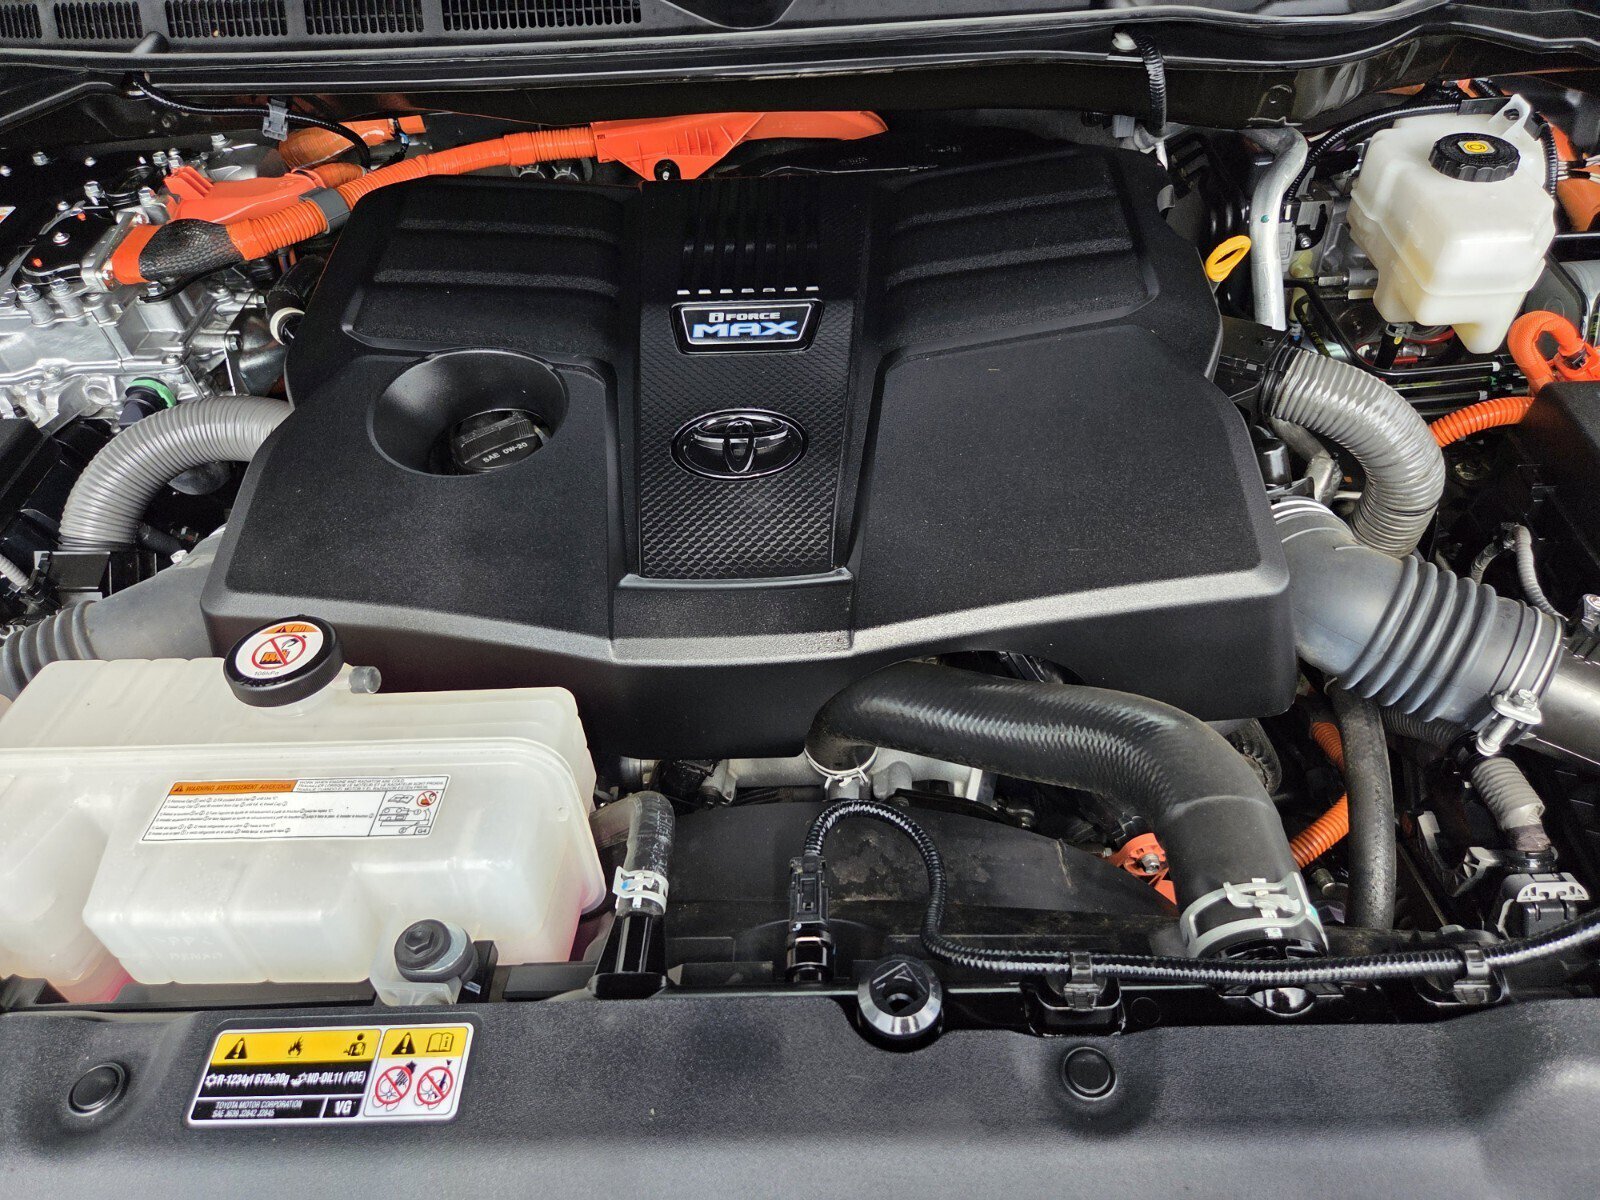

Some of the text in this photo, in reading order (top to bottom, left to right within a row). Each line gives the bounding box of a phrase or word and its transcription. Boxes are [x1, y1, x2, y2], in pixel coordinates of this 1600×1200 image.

[692, 320, 798, 338] MAX
[482, 441, 528, 463] SAE 0W-20
[185, 784, 214, 792] WARNING
[215, 1100, 303, 1110] TOYOTA MOTOR CORPORATION
[334, 1099, 353, 1116] VG
[212, 1109, 226, 1118] SAE
